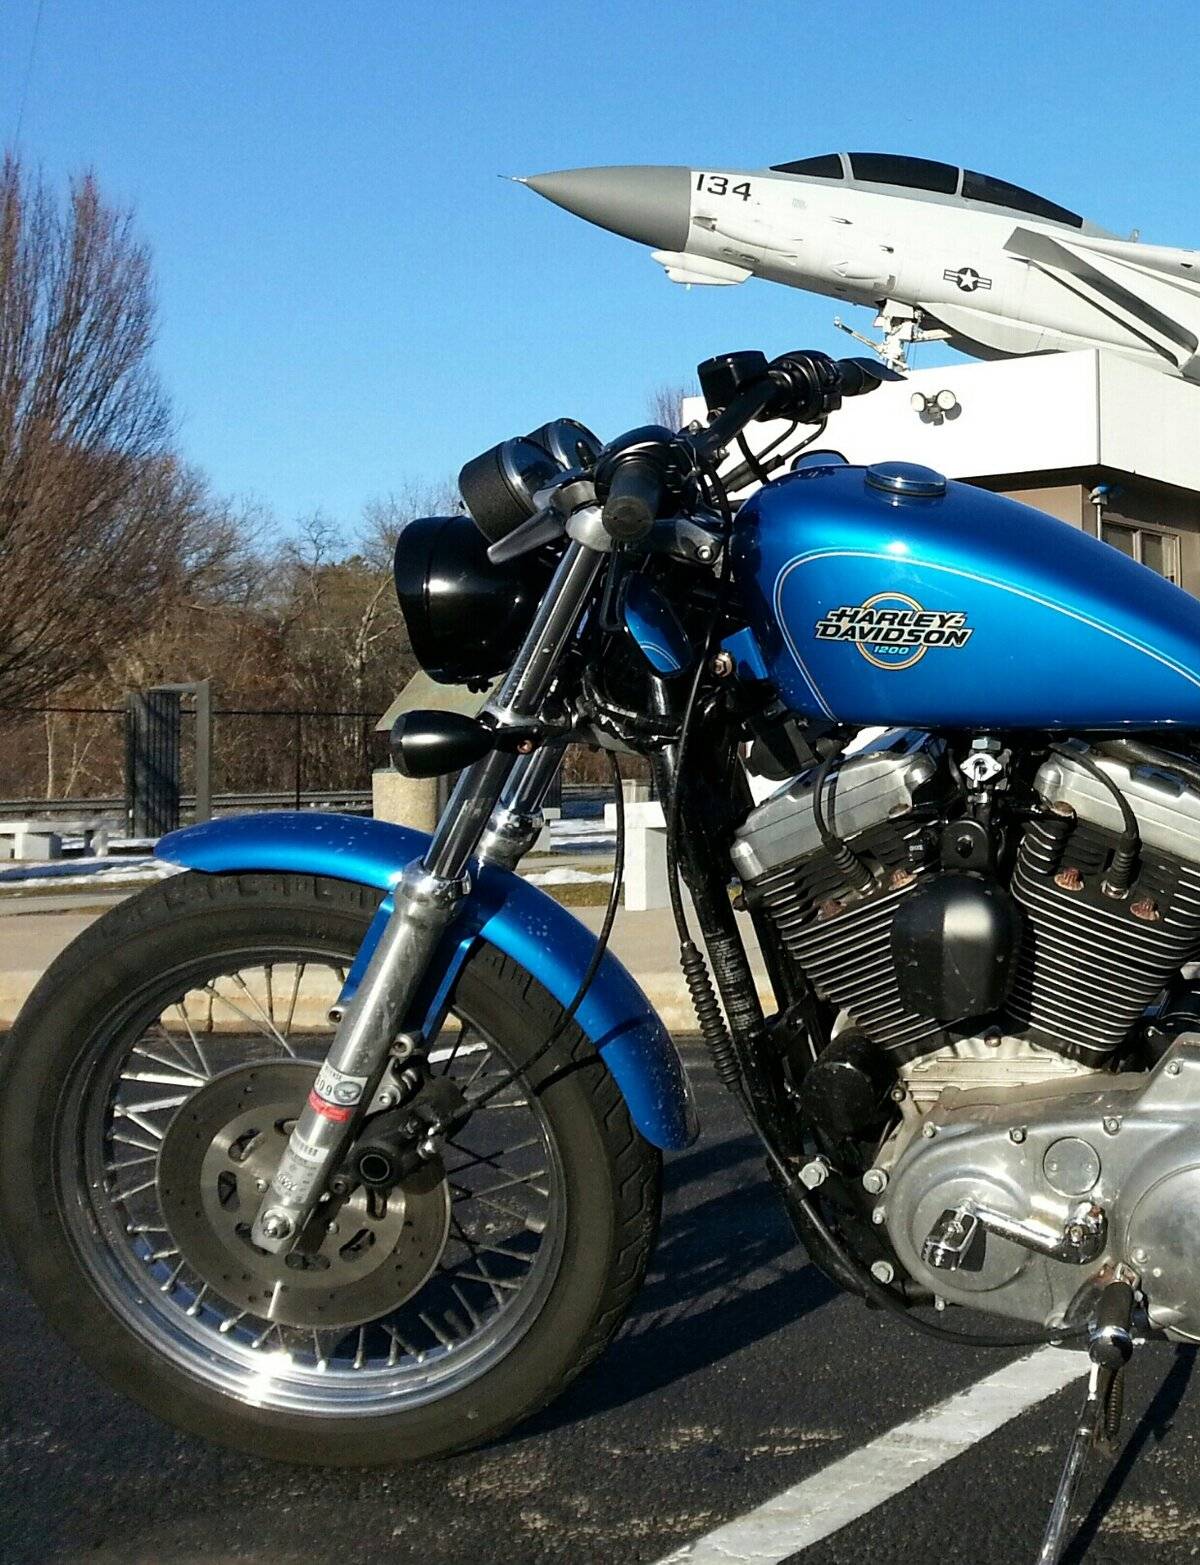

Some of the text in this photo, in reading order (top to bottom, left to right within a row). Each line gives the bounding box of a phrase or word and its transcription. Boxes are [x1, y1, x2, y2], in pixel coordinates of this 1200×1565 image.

[696, 173, 752, 201] 134
[816, 622, 974, 647] DAVIDSON
[874, 645, 910, 655] 1200
